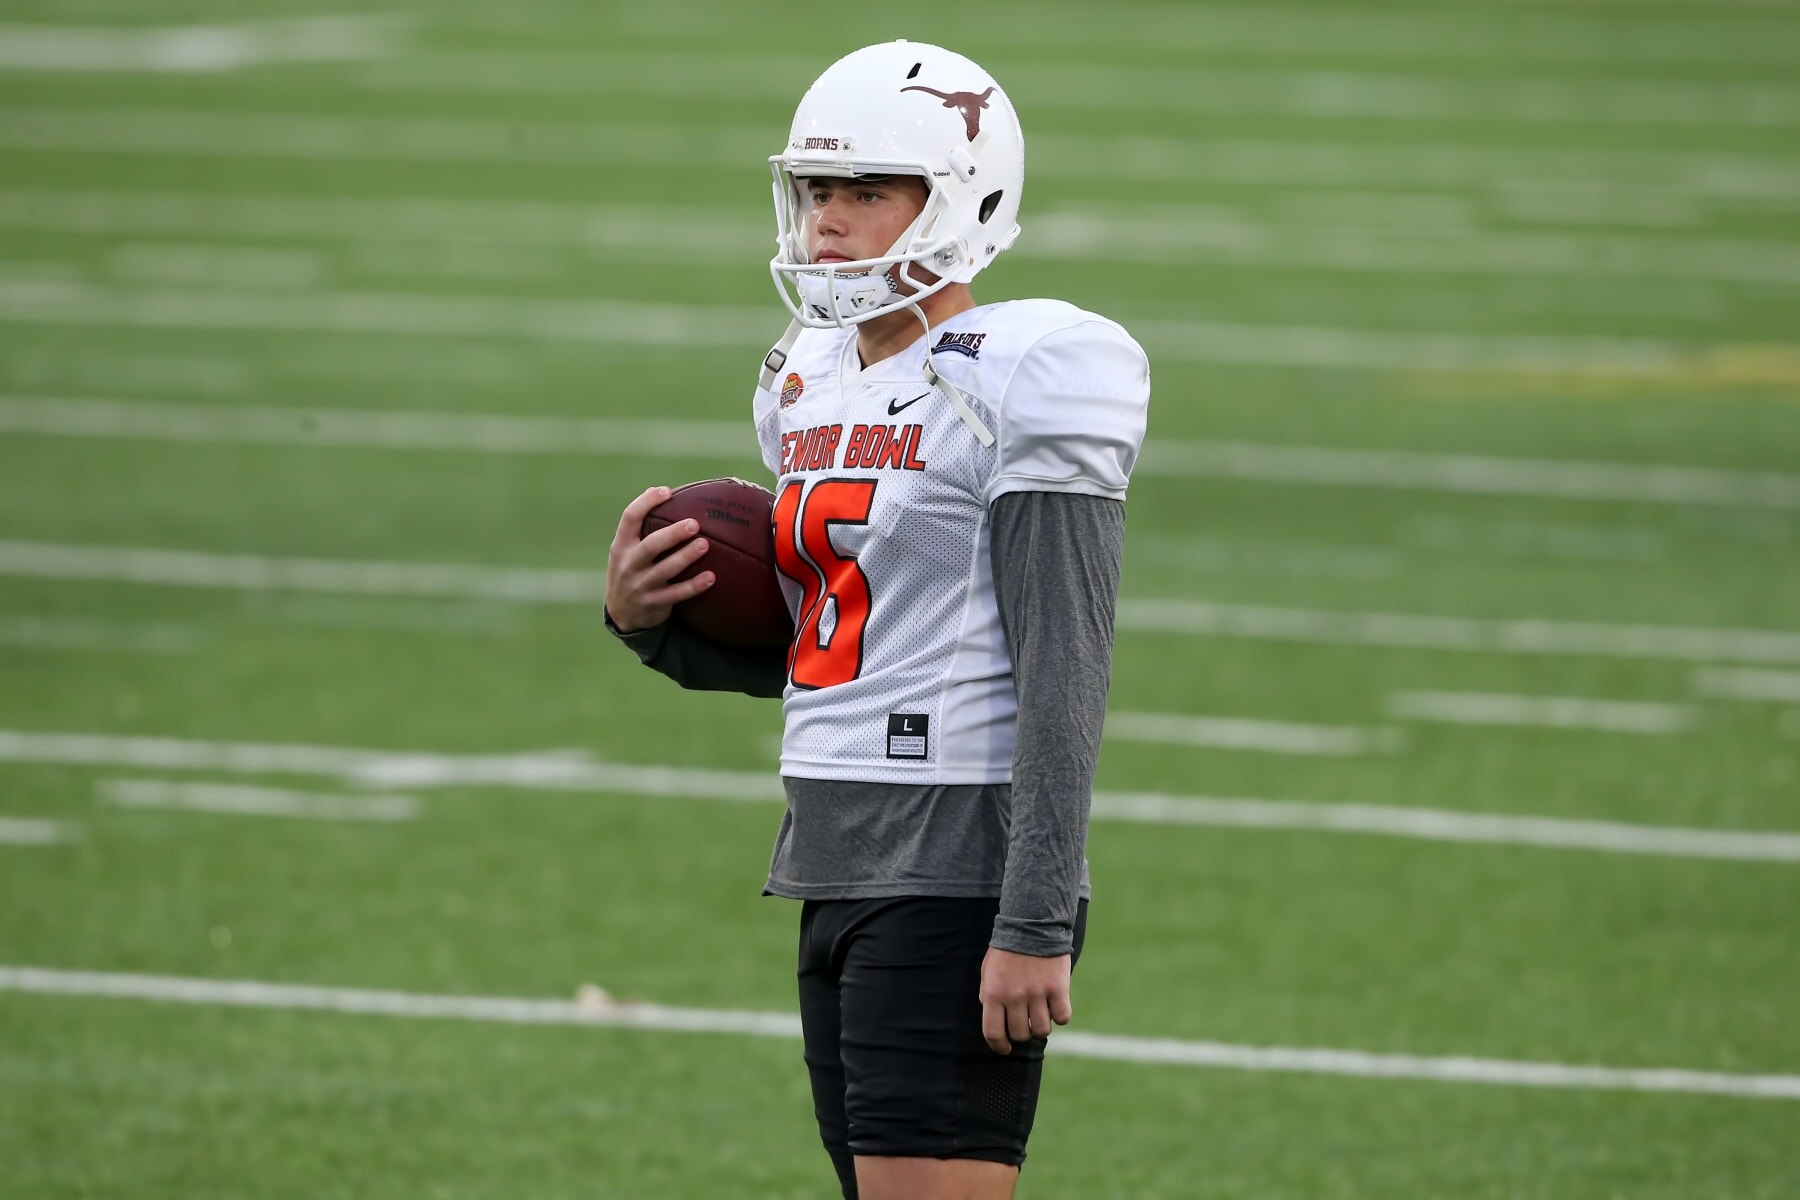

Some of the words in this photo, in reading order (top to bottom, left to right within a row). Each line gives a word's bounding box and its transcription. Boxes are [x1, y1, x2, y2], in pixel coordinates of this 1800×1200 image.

[804, 137, 839, 151] HORNS
[780, 423, 843, 476] ENIOR
[843, 424, 926, 472] BOWL
[773, 478, 878, 691] 16
[903, 718, 913, 731] L
